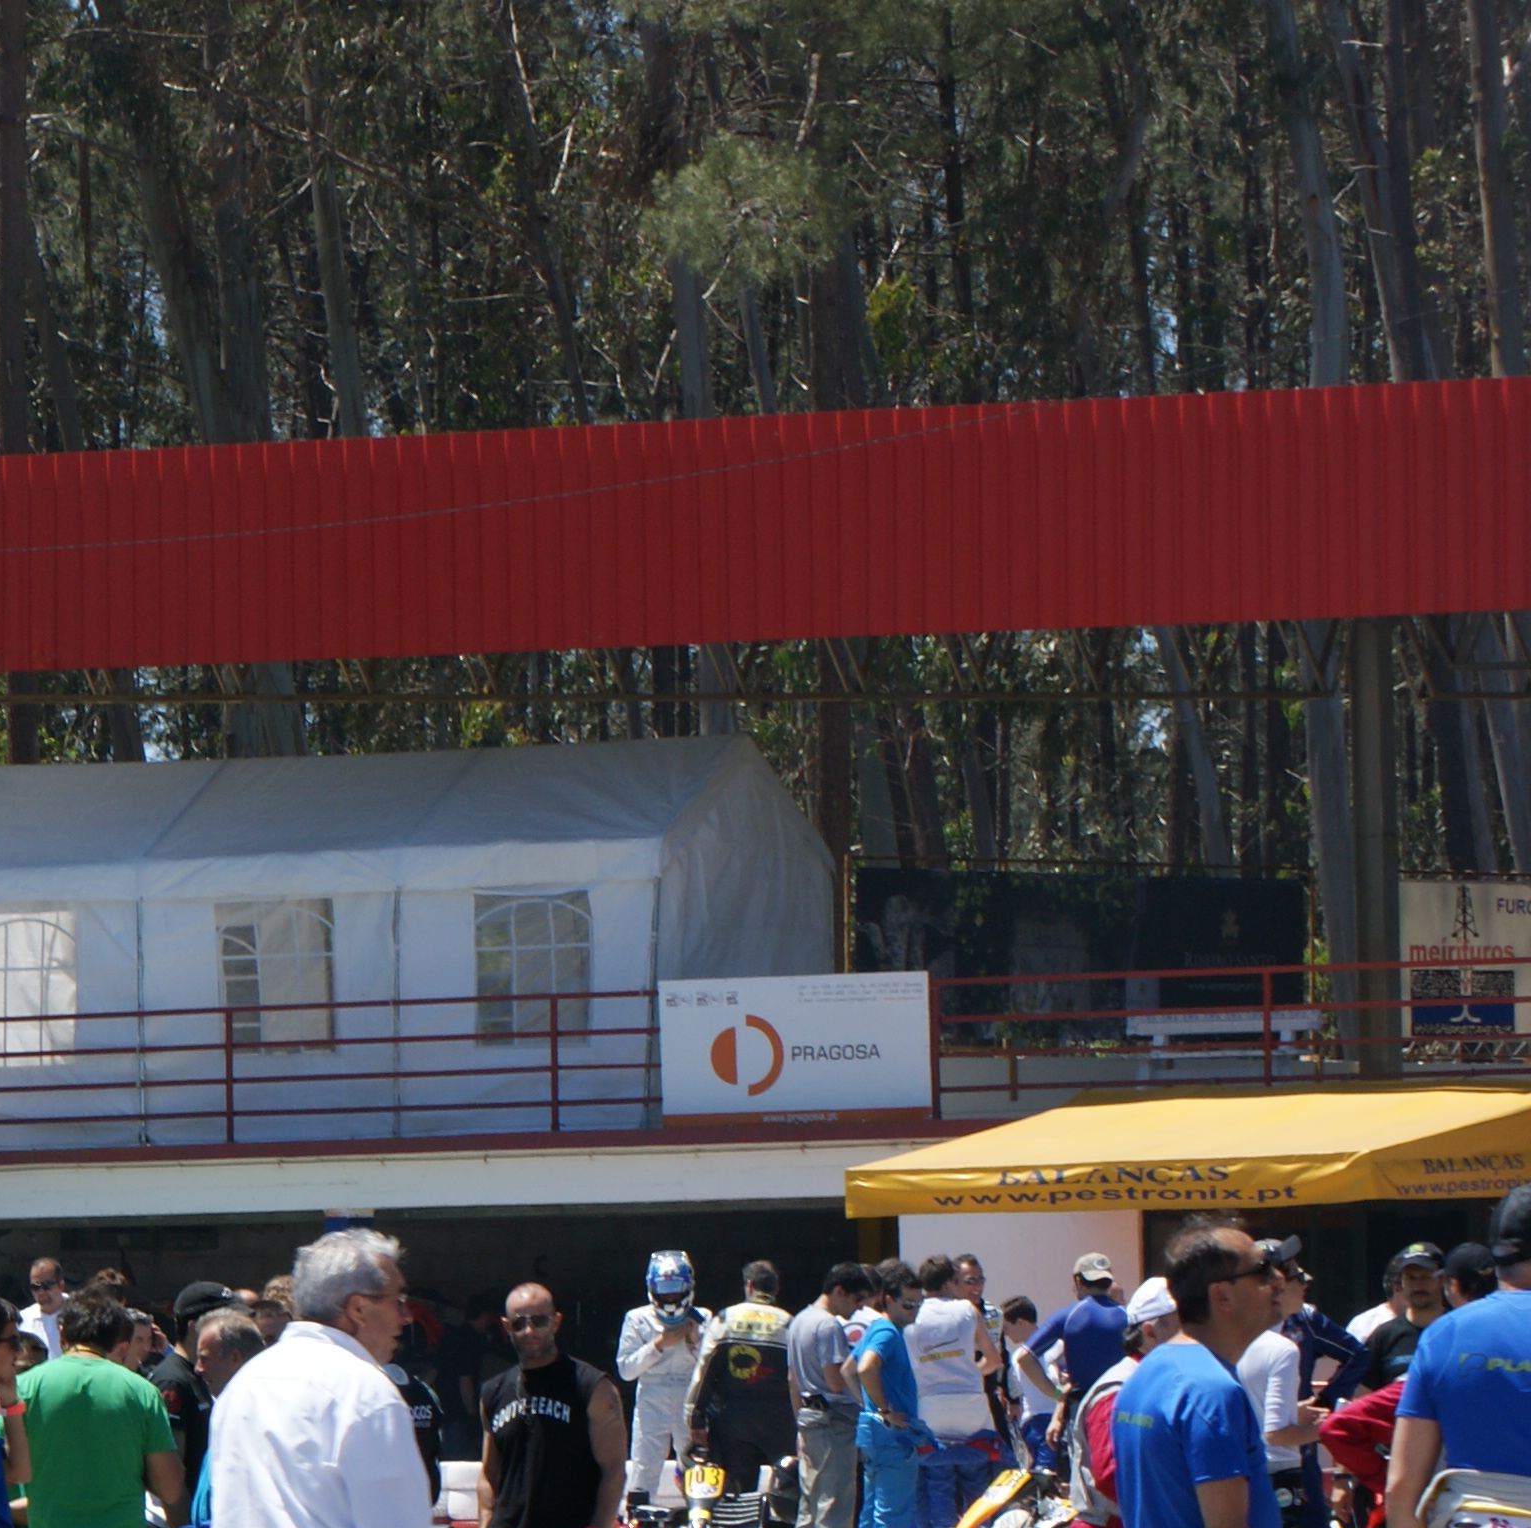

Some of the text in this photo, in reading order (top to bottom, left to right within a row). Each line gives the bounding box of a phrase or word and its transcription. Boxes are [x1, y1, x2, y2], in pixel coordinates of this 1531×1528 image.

[791, 1043, 881, 1061] PRAGOSA
[1422, 1153, 1525, 1174] BALANÇAS
[934, 1184, 1298, 1206] www.pestronix.pt
